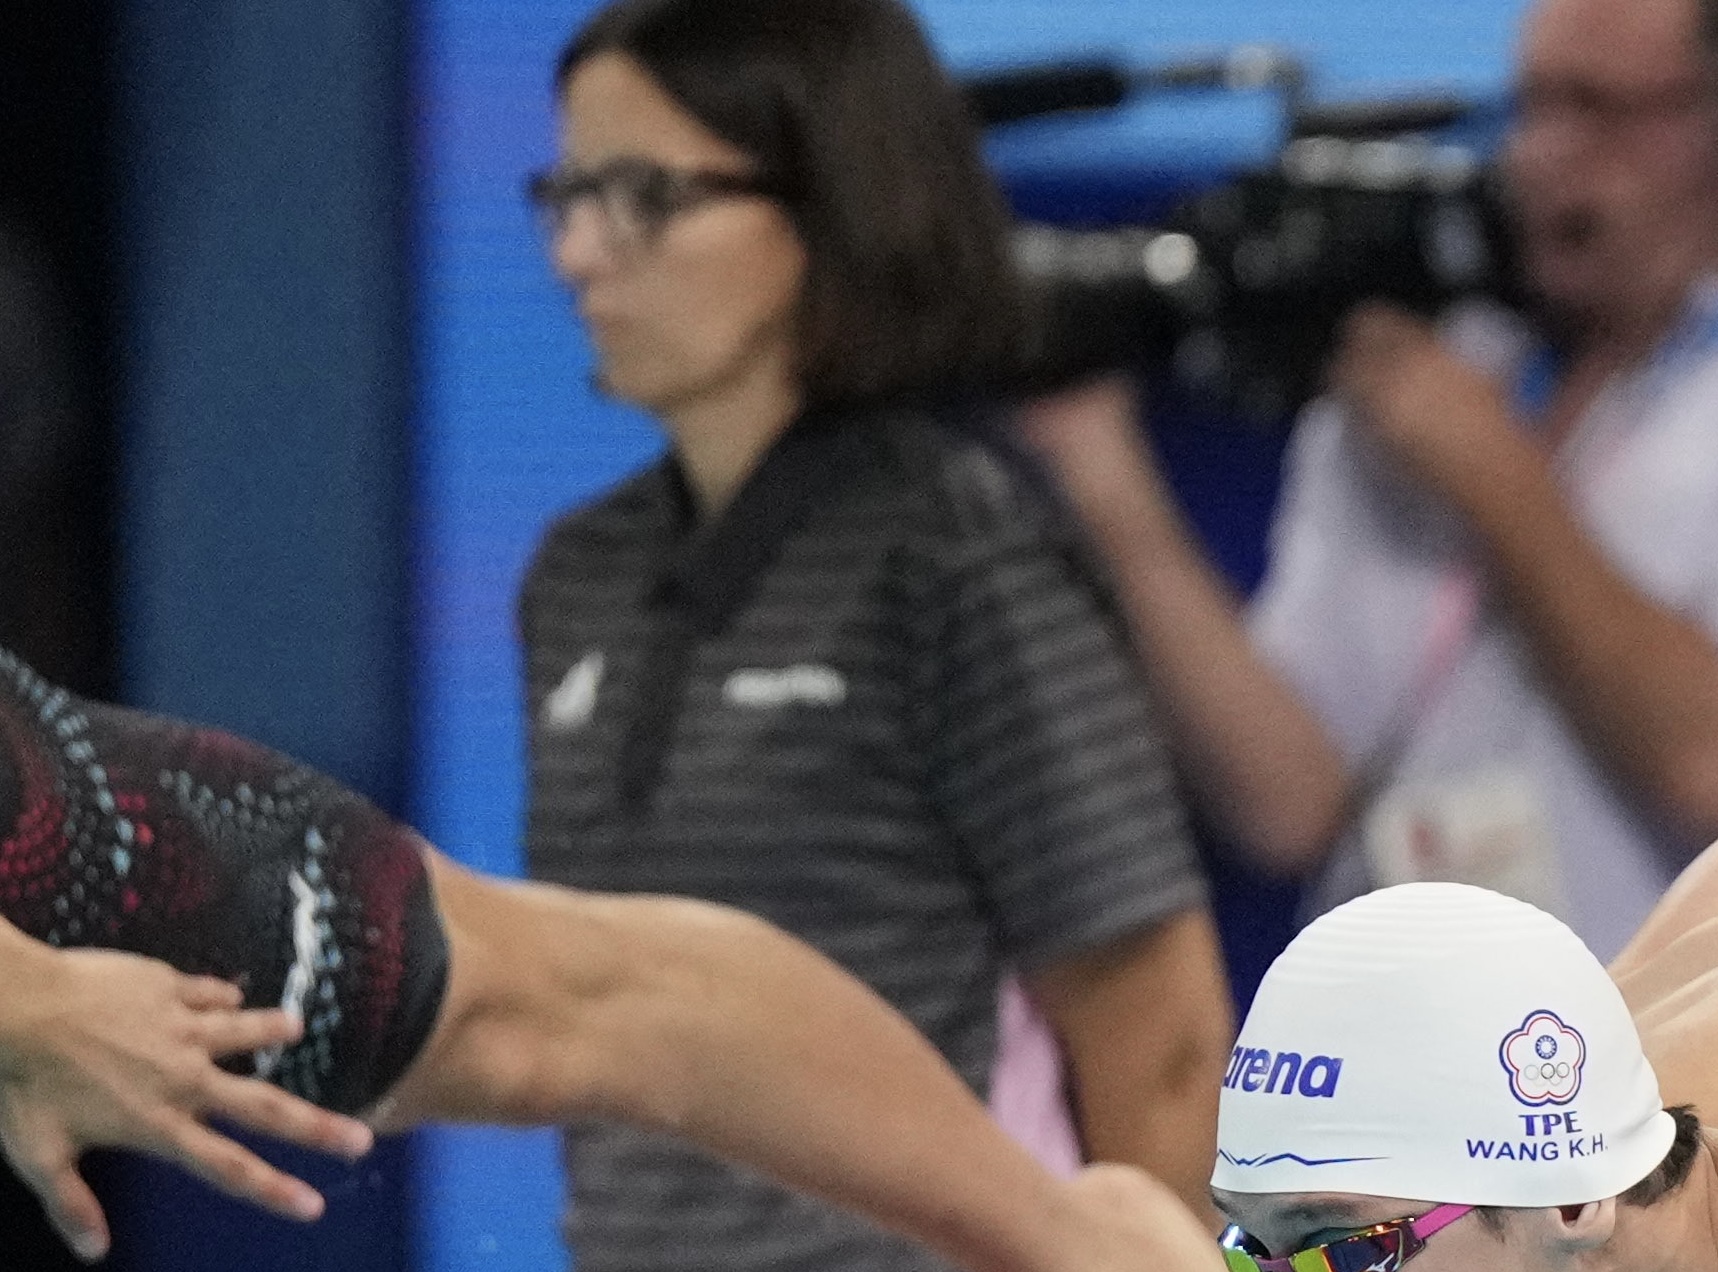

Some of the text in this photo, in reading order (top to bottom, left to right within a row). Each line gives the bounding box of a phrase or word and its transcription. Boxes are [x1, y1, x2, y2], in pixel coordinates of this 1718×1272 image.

[1518, 1110, 1583, 1137] TPE
[1466, 1132, 1608, 1162] WANG K.H.
